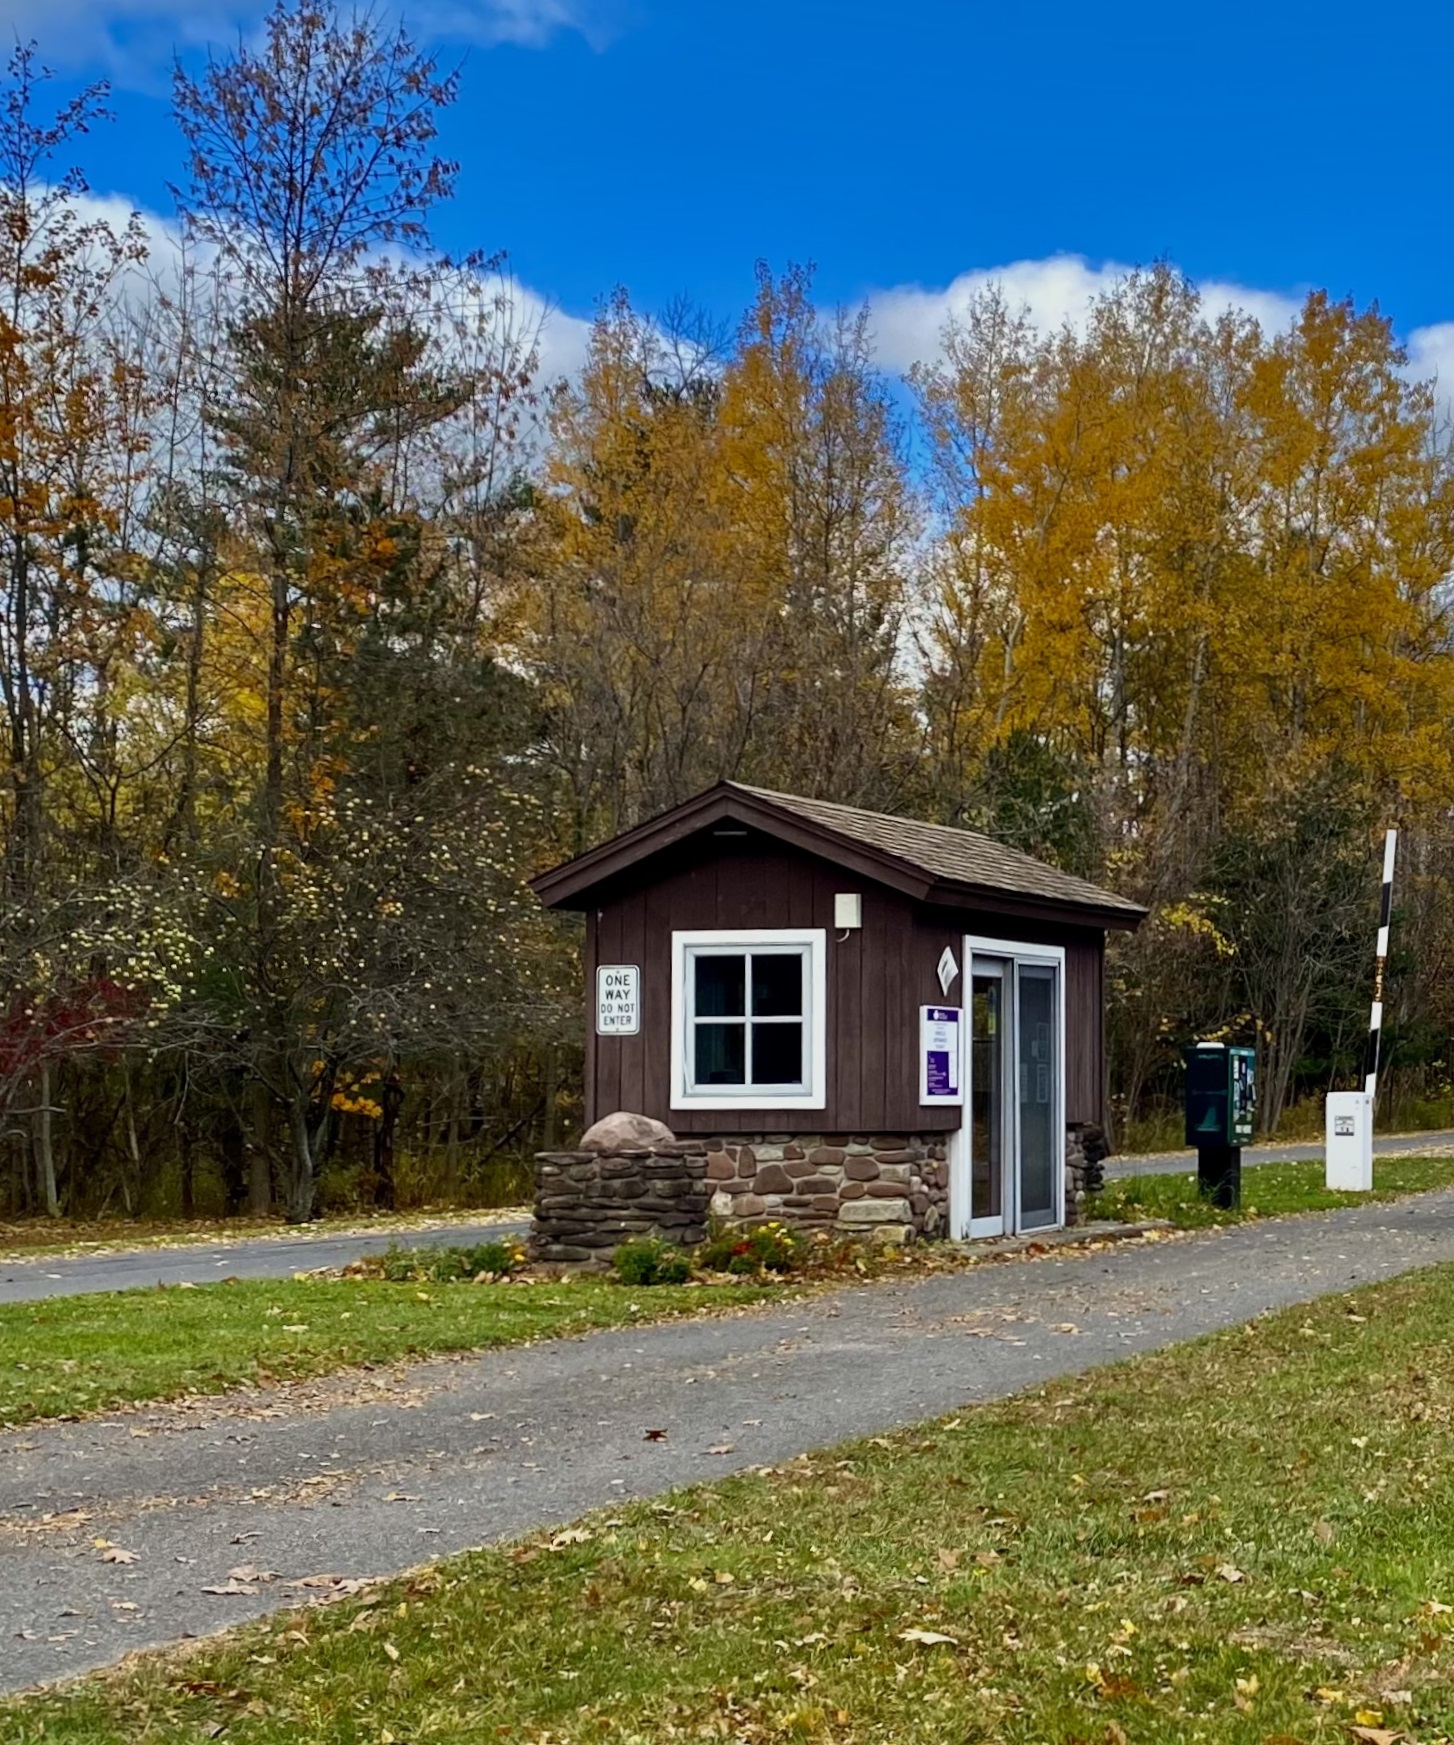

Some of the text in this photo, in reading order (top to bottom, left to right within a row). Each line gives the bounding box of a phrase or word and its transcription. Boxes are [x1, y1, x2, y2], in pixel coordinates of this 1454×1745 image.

[605, 974, 631, 987] ONE
[605, 989, 631, 1000] WAY
[600, 1003, 635, 1014] DO NOT
[603, 1015, 632, 1026] ENTER
